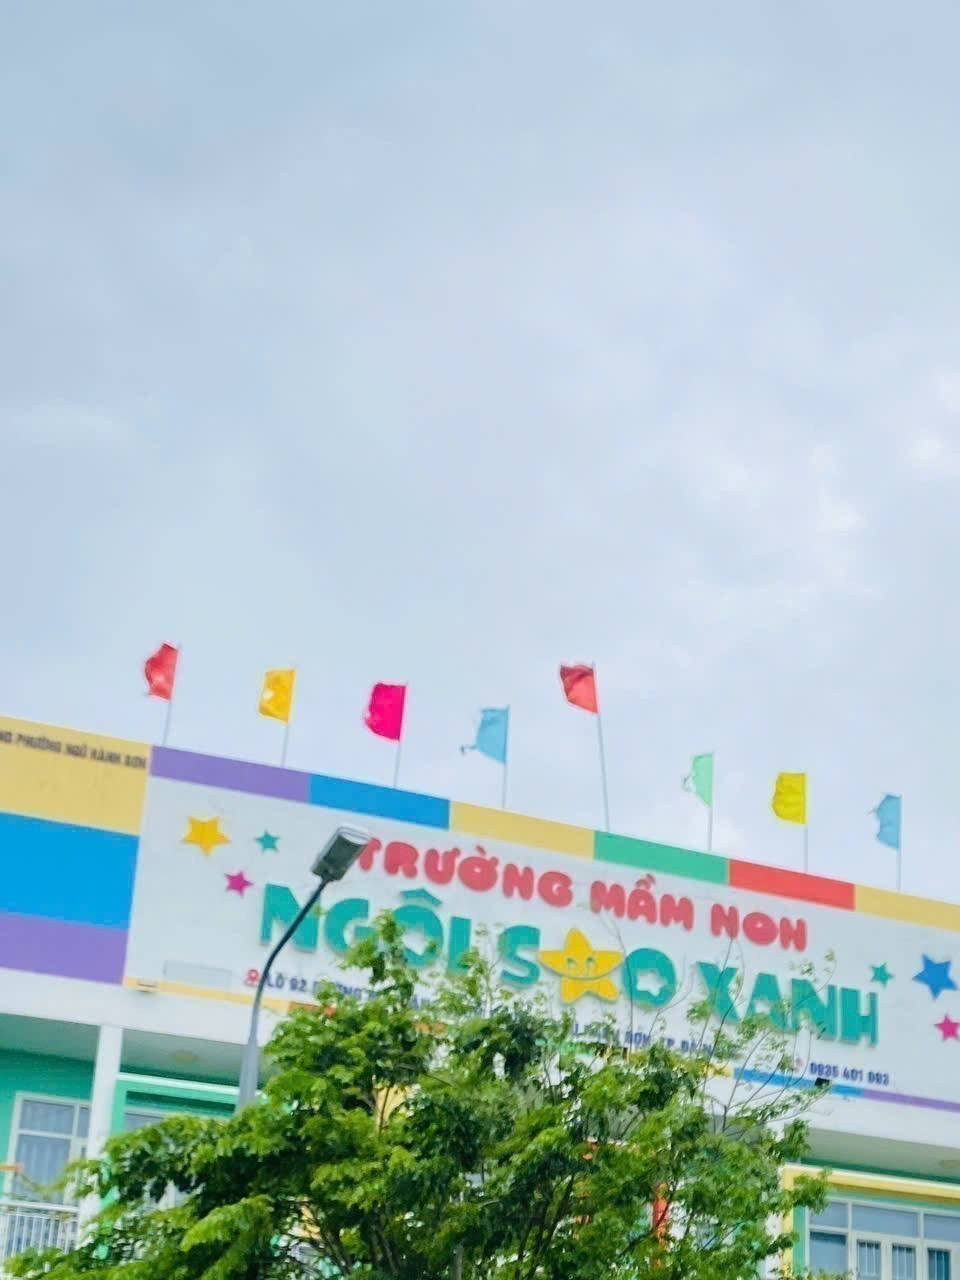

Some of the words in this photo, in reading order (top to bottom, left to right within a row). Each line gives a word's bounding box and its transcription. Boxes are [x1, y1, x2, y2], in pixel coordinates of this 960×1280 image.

[359, 837, 573, 908] TRƯỜNG
[590, 873, 694, 932] MẦM
[711, 903, 807, 952] NON
[260, 883, 471, 975] NGÔI
[696, 961, 878, 1048] XANH
